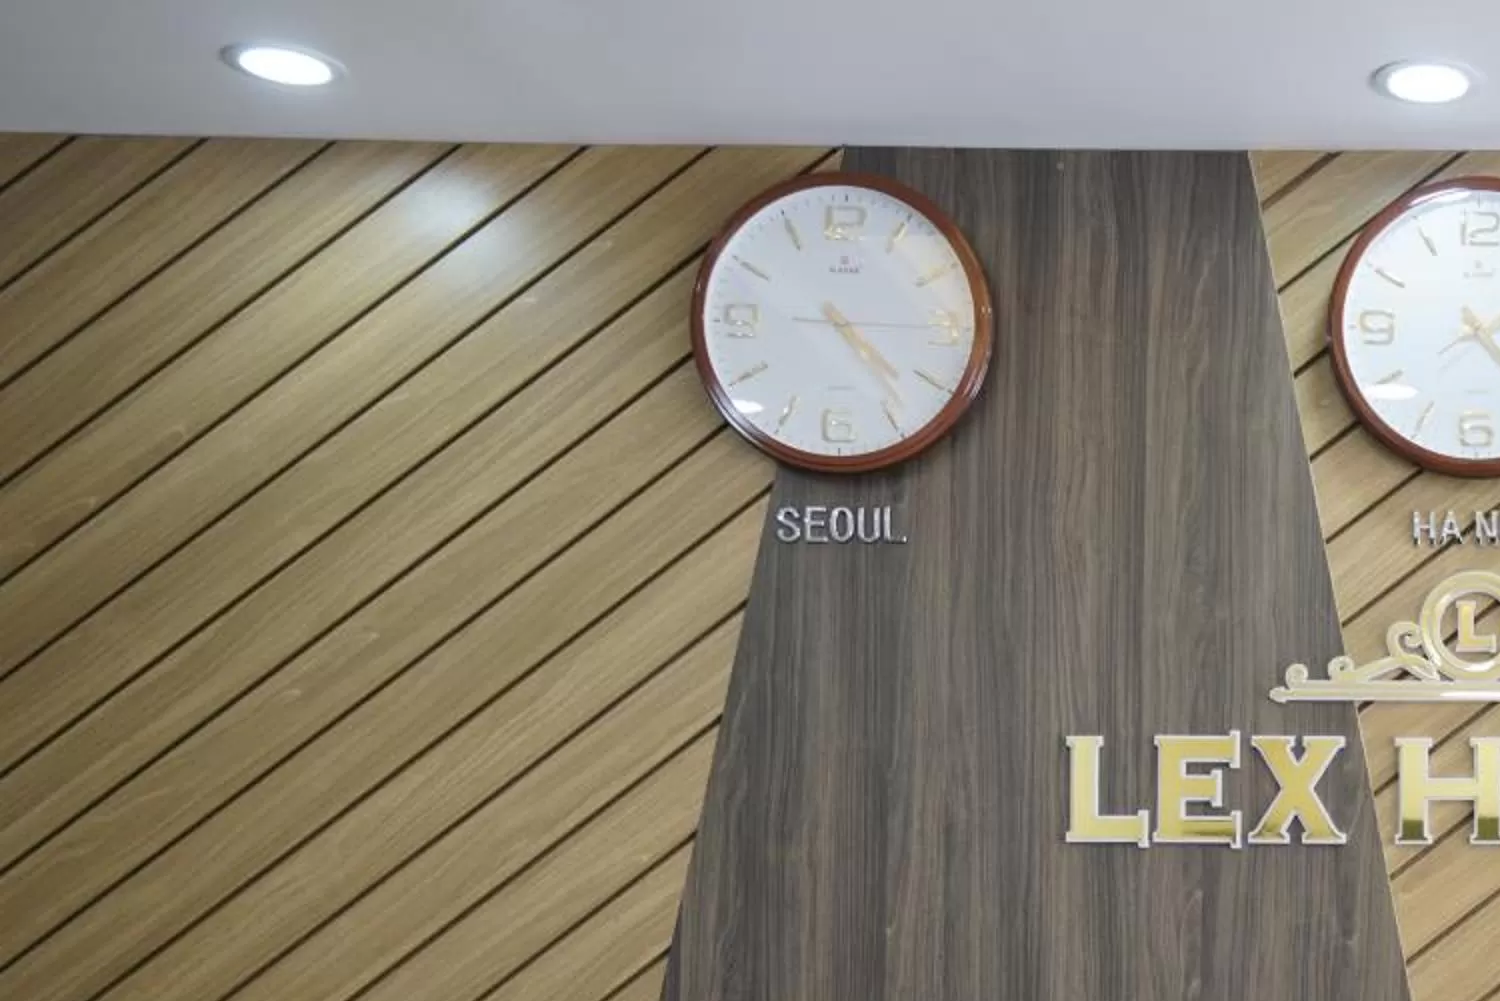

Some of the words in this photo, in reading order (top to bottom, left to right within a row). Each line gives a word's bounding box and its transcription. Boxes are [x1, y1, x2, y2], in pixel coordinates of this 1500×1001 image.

[1460, 211, 1500, 247] 12
[723, 303, 759, 338] 9
[1359, 310, 1395, 345] 9
[821, 408, 856, 443] 6
[1459, 413, 1493, 448] 6
[775, 505, 908, 544] SEOUL
[1455, 599, 1497, 653] L
[1065, 730, 1347, 850] LEX
